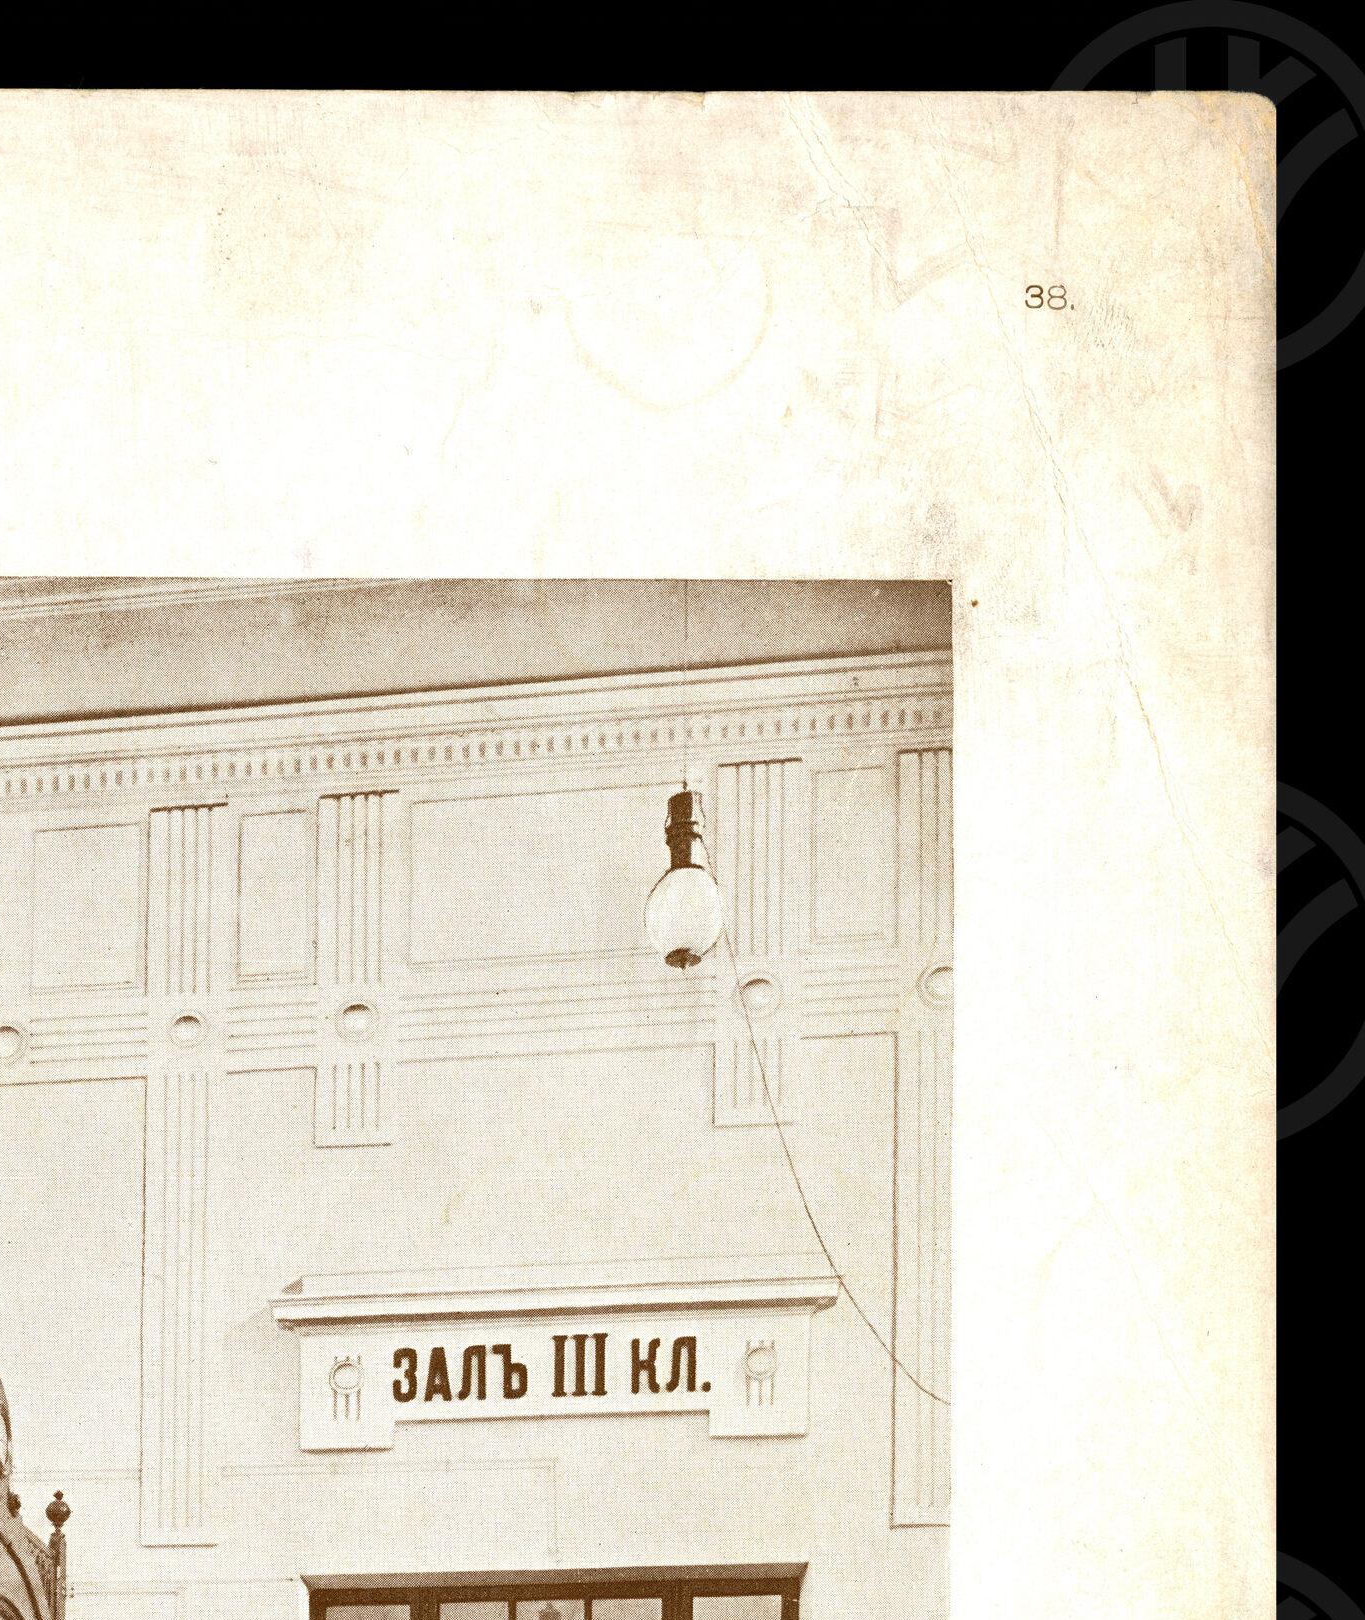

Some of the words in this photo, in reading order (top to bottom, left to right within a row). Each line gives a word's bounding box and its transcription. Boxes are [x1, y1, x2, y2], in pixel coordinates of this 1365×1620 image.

[1025, 284, 1075, 311] 38.
[392, 1342, 529, 1403] ЗАЛЪ
[551, 1332, 609, 1398] III
[630, 1336, 712, 1395] КЛ.
